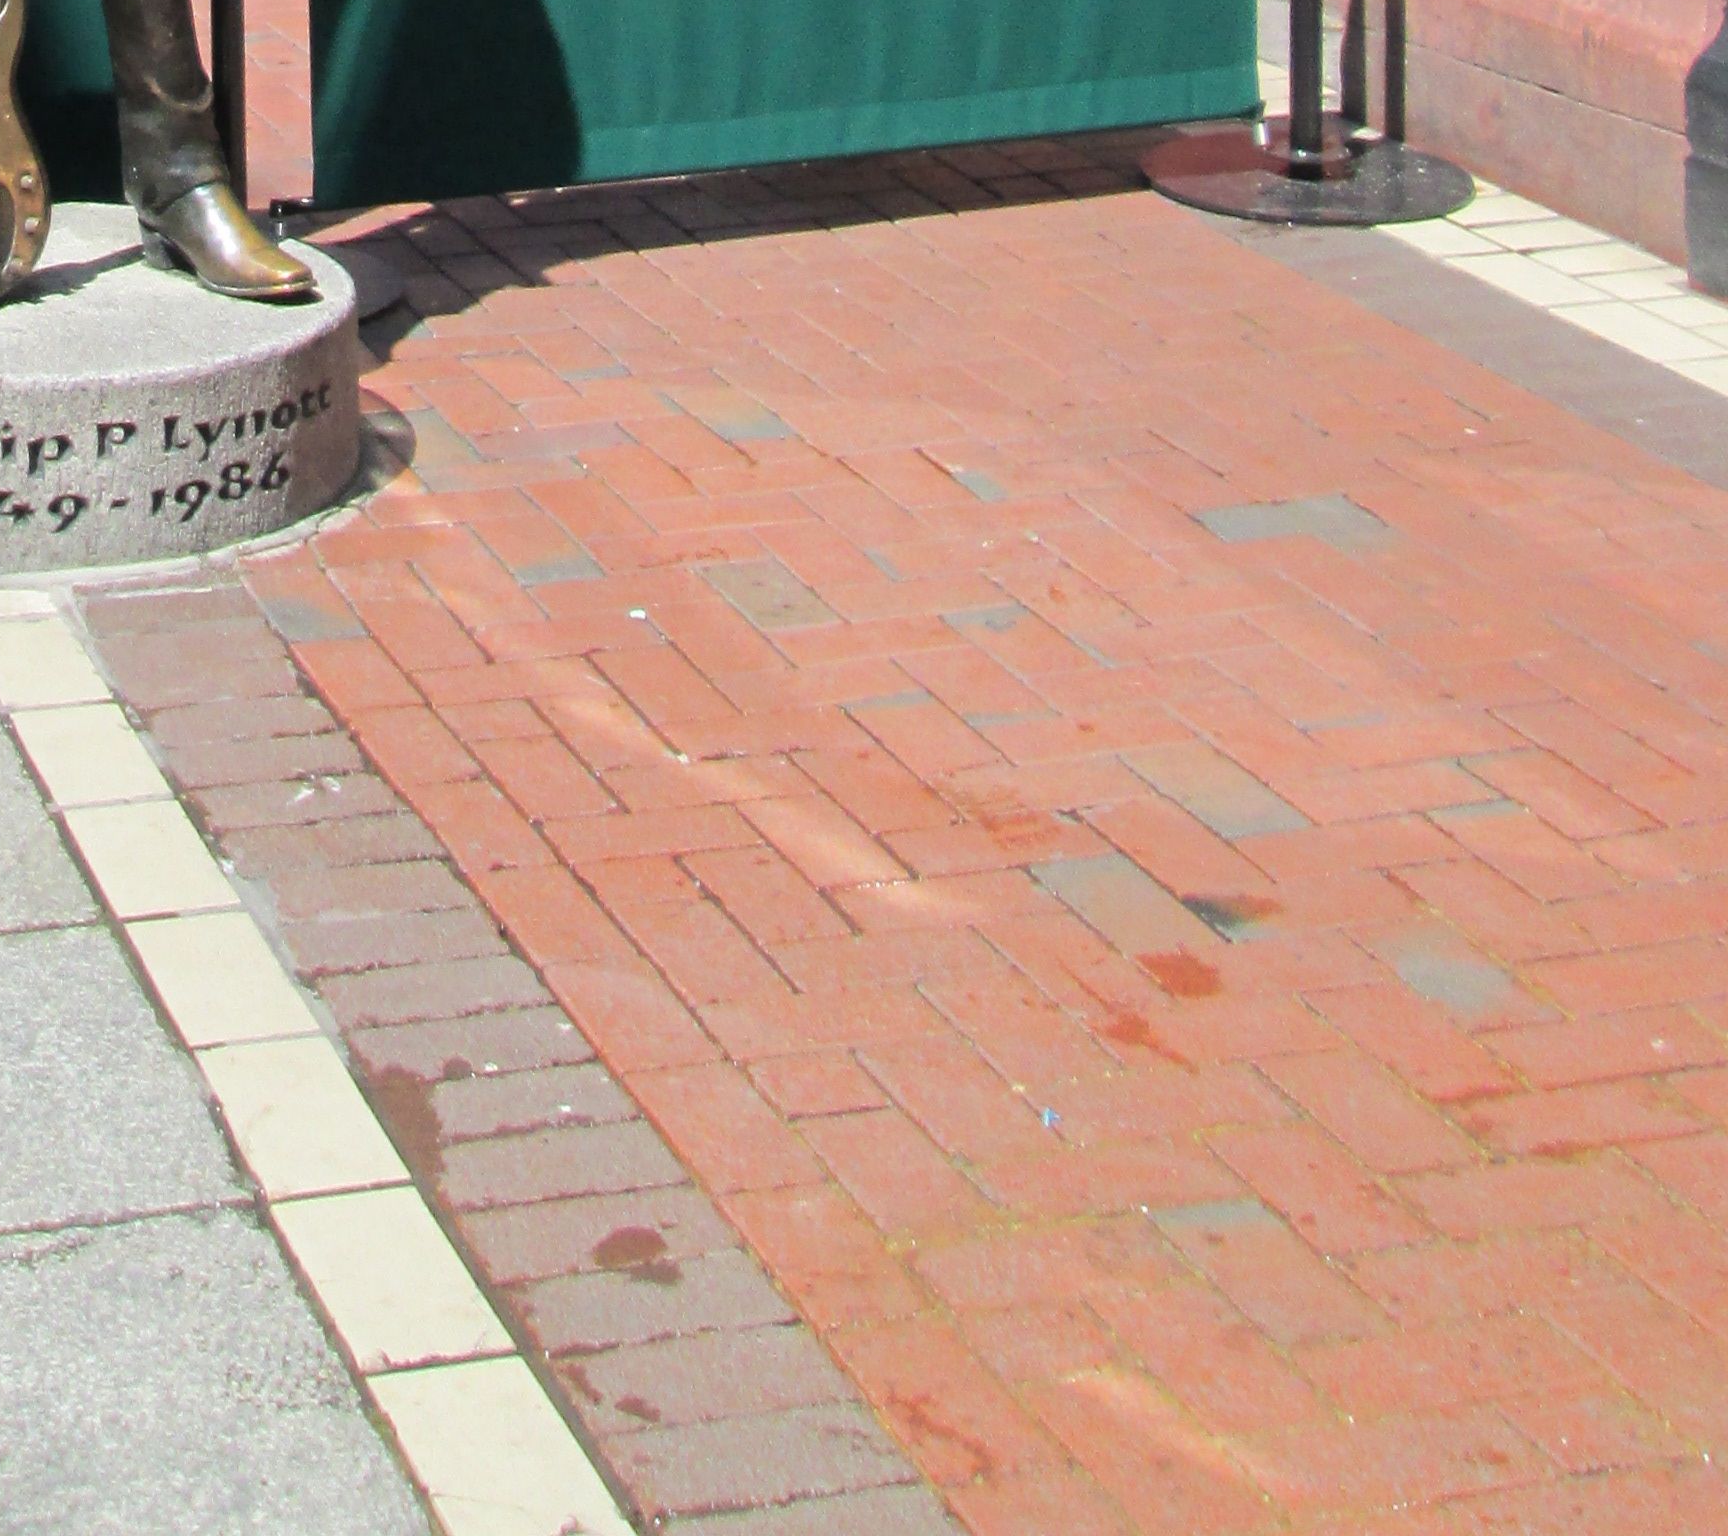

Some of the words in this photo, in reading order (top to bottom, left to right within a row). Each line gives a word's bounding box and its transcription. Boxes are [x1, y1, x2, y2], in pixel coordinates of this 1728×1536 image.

[95, 420, 138, 459] P
[162, 380, 332, 463] Lynott
[149, 452, 291, 524] 1986
